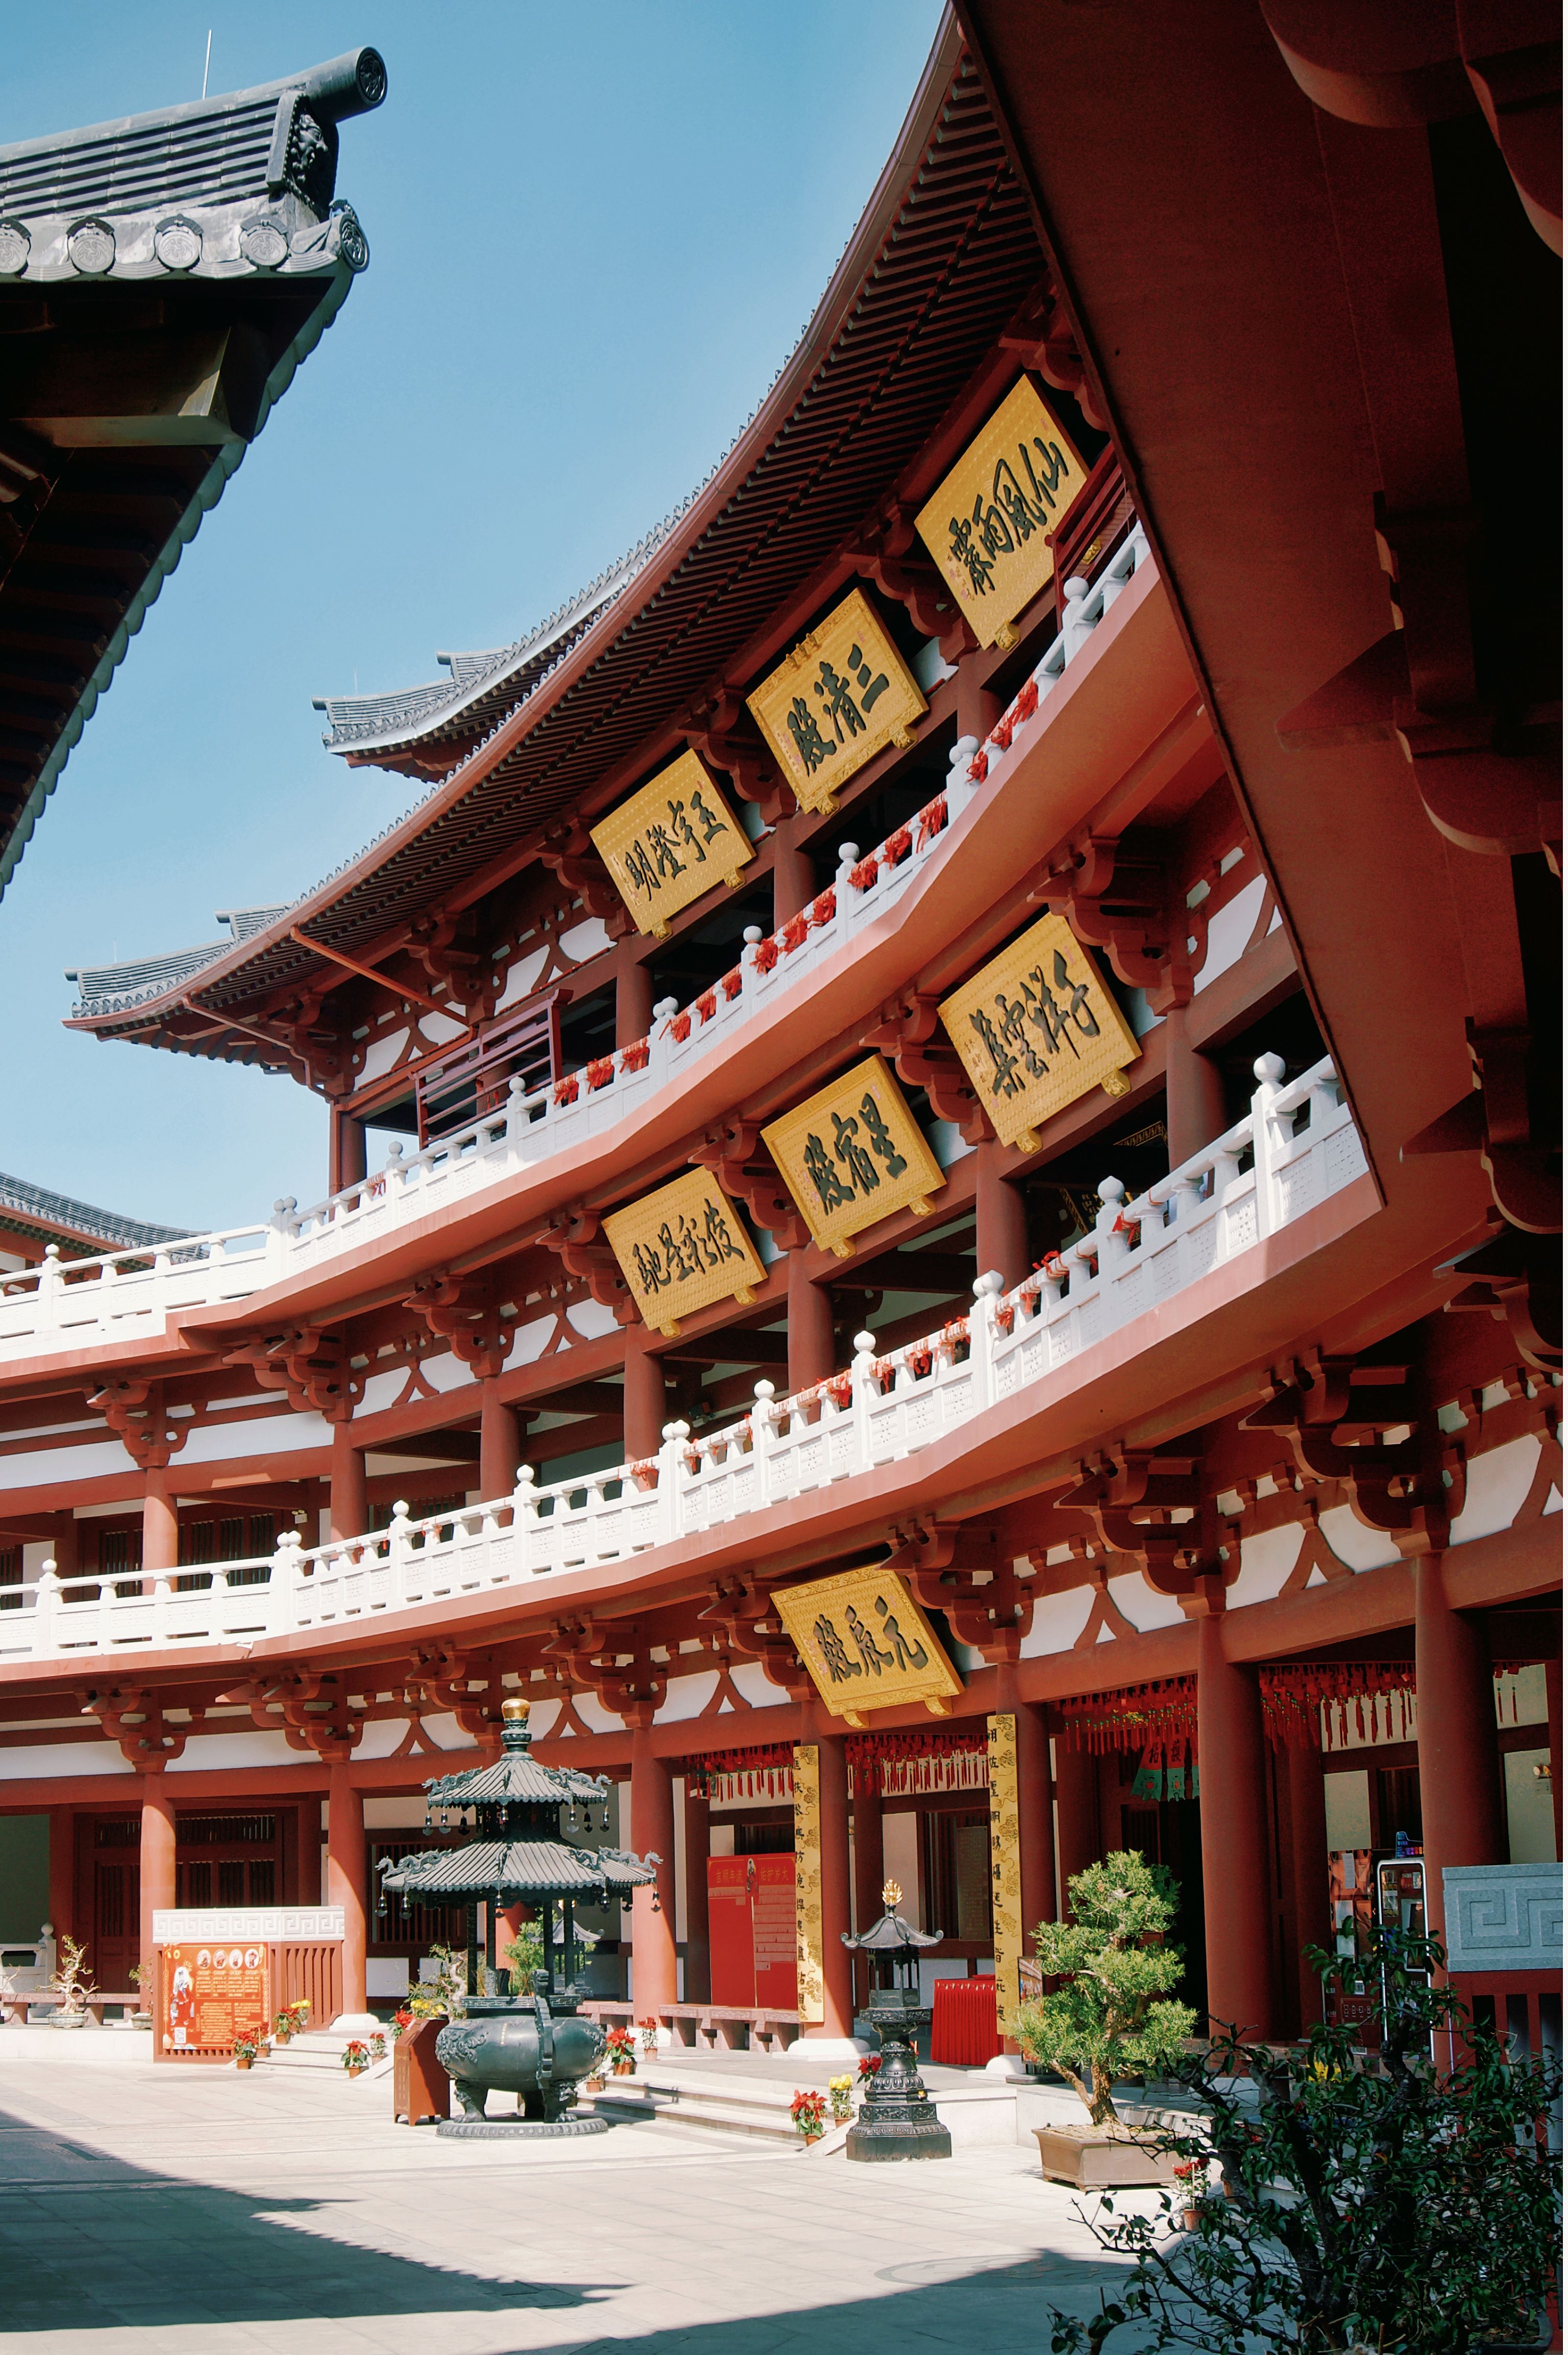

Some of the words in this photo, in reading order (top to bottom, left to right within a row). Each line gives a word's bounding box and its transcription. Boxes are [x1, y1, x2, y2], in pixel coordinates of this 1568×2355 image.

[787, 643, 890, 777] 三清殿
[803, 1092, 908, 1216] 星宿殿
[813, 1595, 929, 1684] 元辰殿
